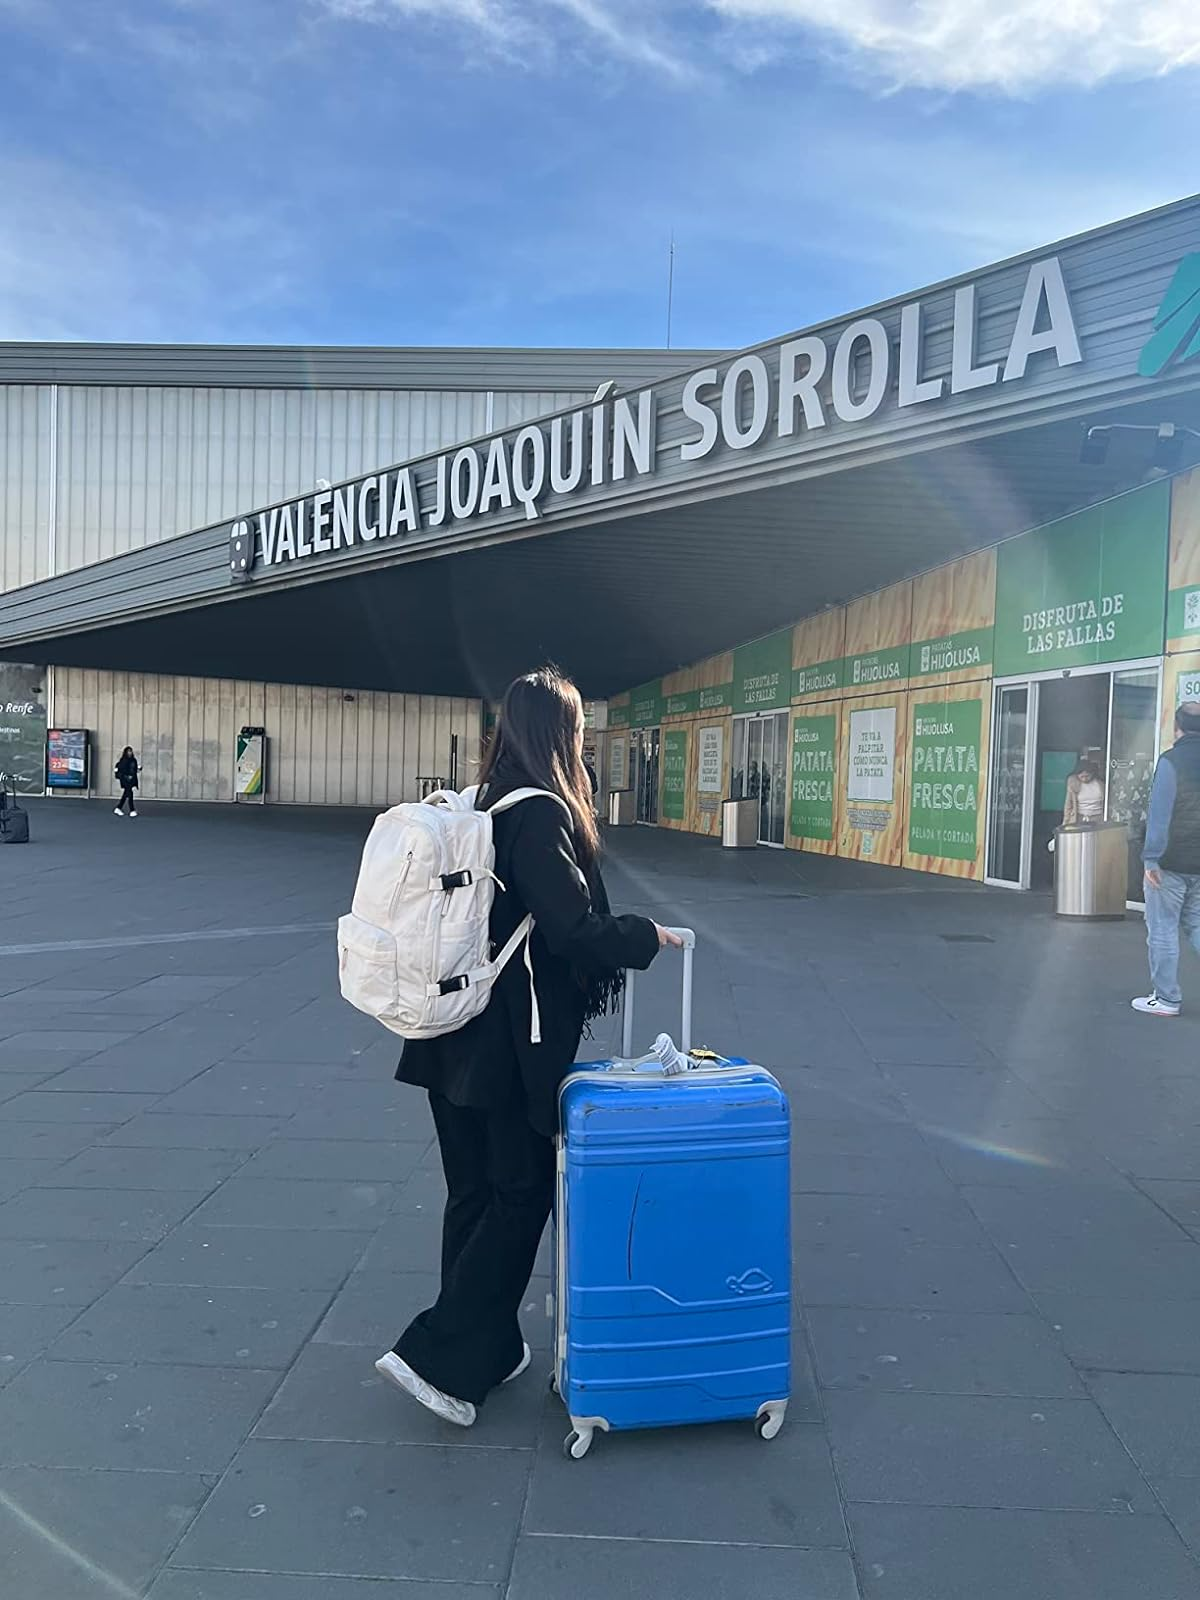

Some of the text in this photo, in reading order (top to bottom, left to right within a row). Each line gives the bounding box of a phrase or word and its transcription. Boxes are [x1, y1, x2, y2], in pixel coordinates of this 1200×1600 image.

[259, 256, 1083, 566] VALÈNCIA JOAQUÍN SOROLLA
[1023, 594, 1124, 632] DISFRUTA DE
[1027, 621, 1116, 654] LAS FALLAS
[931, 646, 980, 671] HIJOLUSA
[6, 702, 34, 716] Renfe
[793, 750, 834, 772] PATATA
[913, 745, 978, 773] PATATA
[792, 779, 833, 801] FRESCA
[912, 782, 977, 811] FRESCA
[911, 827, 975, 844] PELADA Y CORTADA
